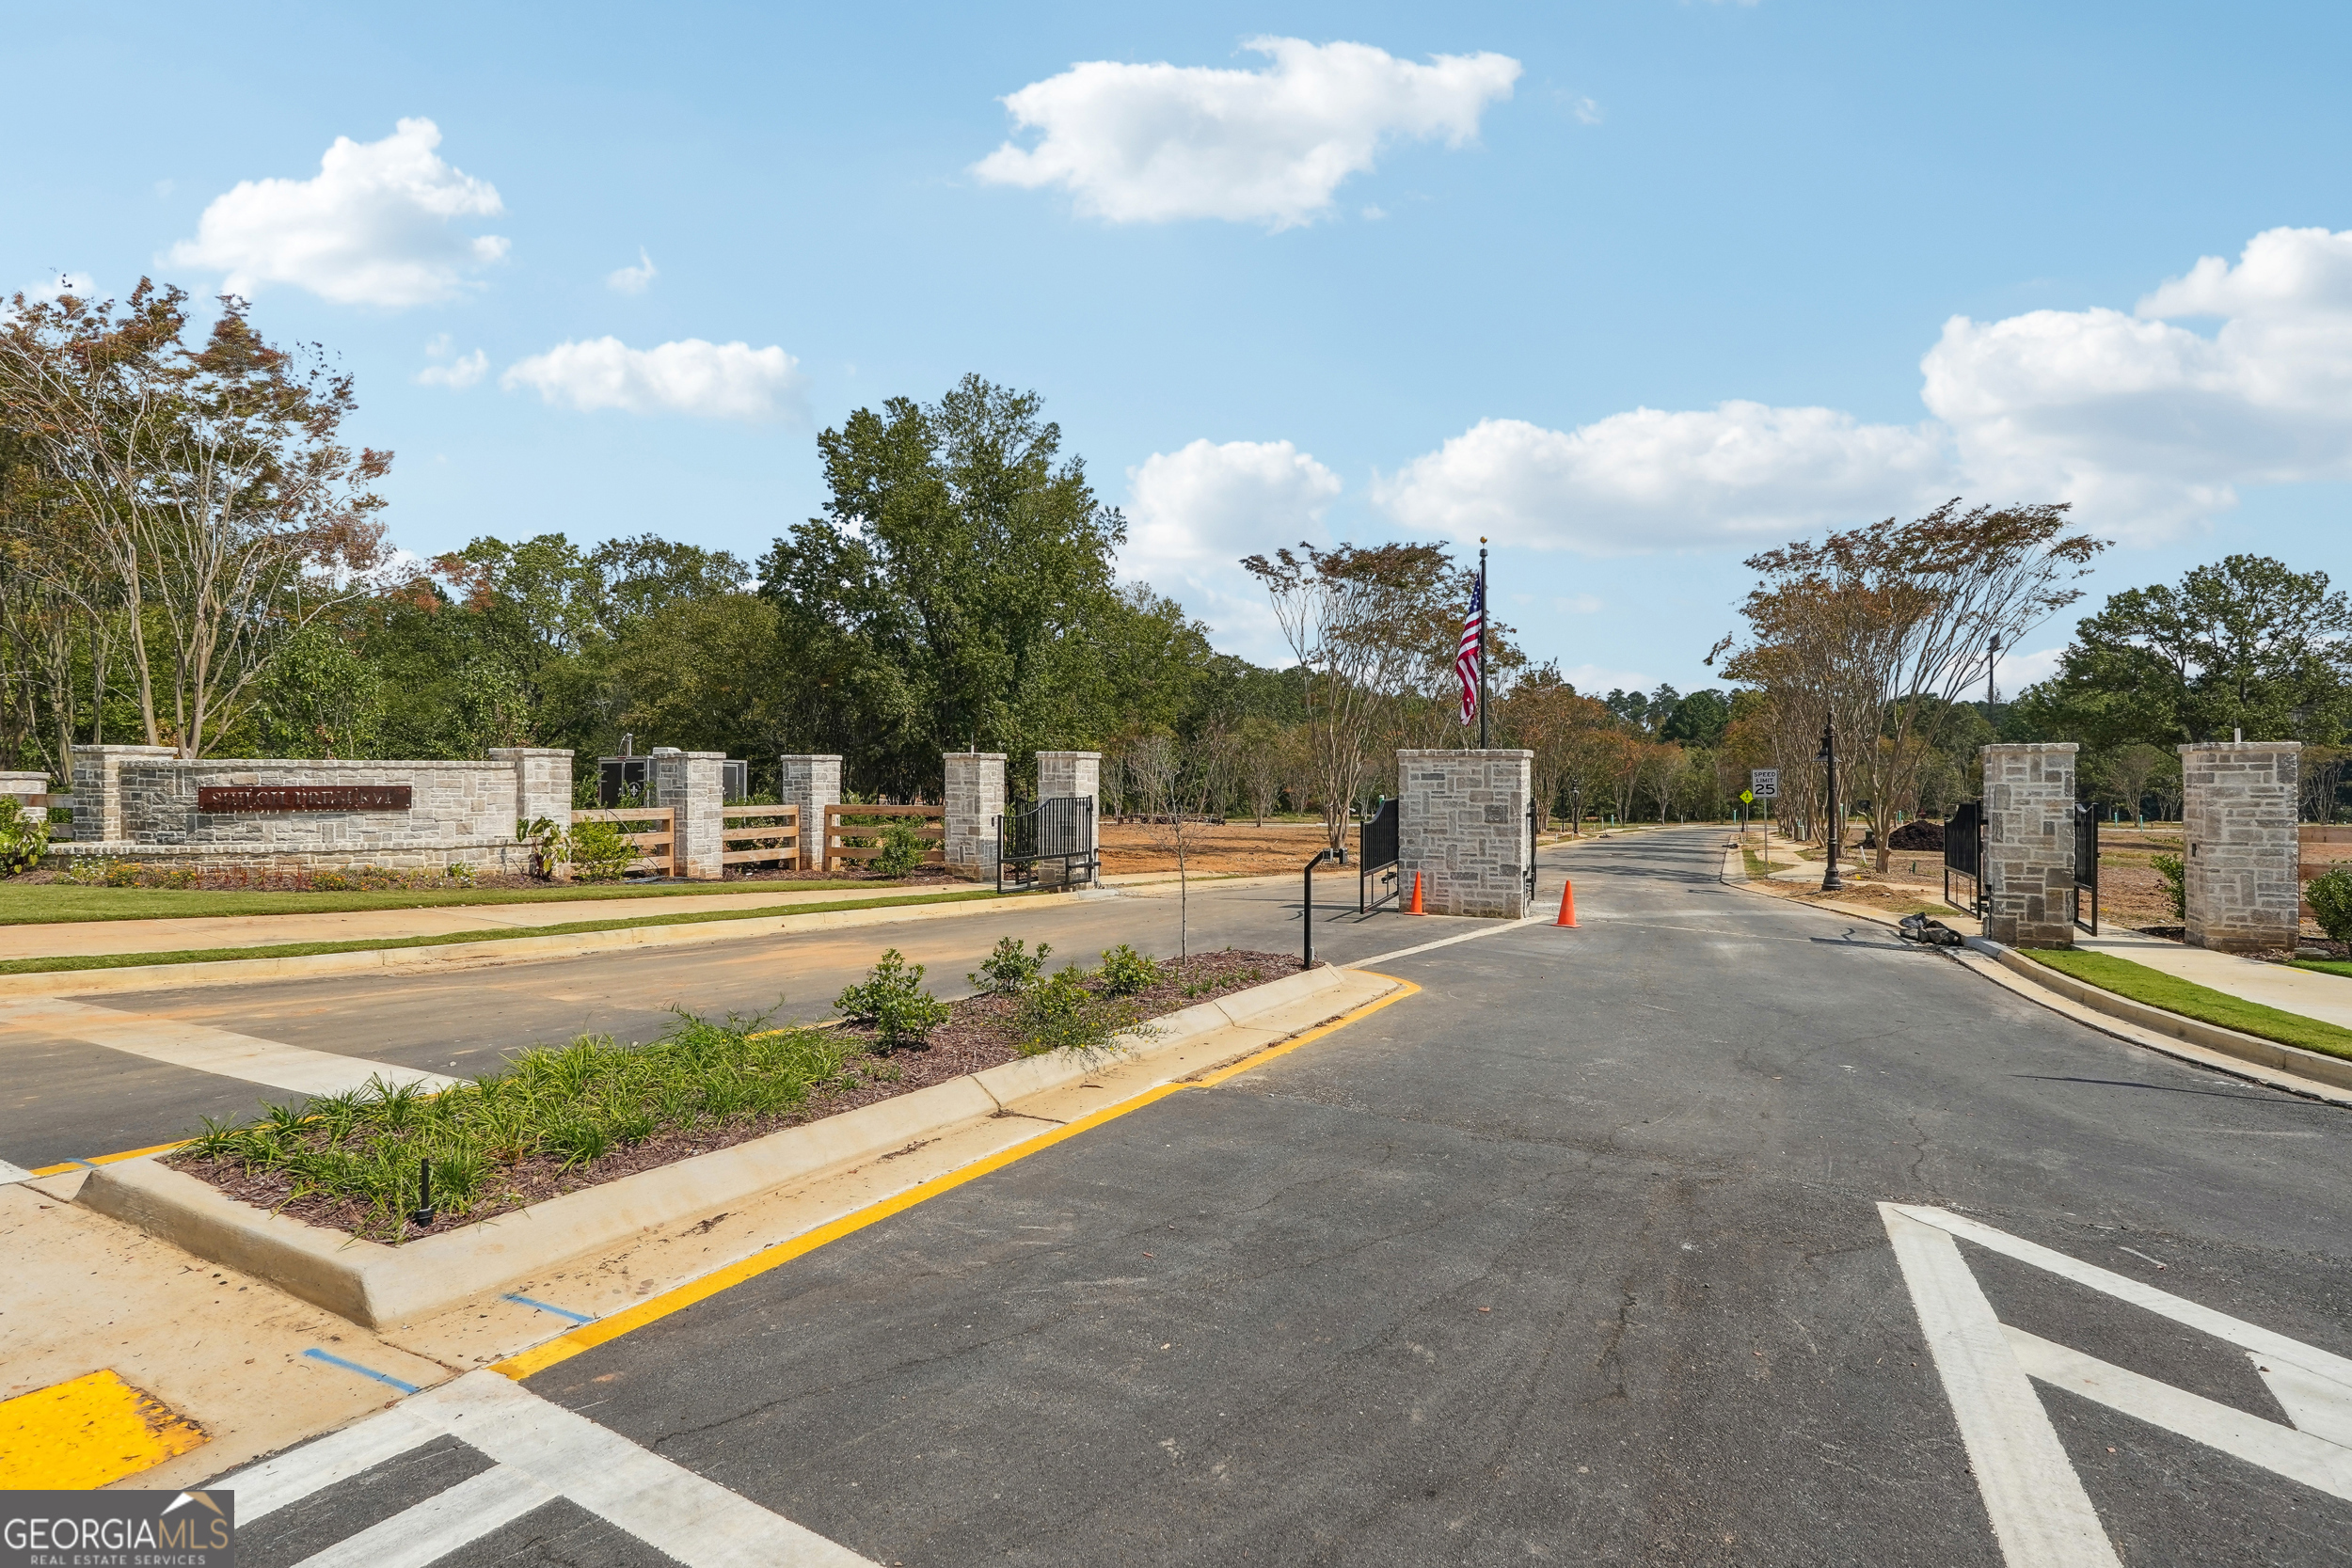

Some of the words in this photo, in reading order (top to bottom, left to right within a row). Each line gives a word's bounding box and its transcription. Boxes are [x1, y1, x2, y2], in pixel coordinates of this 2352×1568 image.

[1755, 784, 1775, 795] 25
[212, 791, 286, 806] SHILOH
[294, 791, 393, 805] PRESERVE
